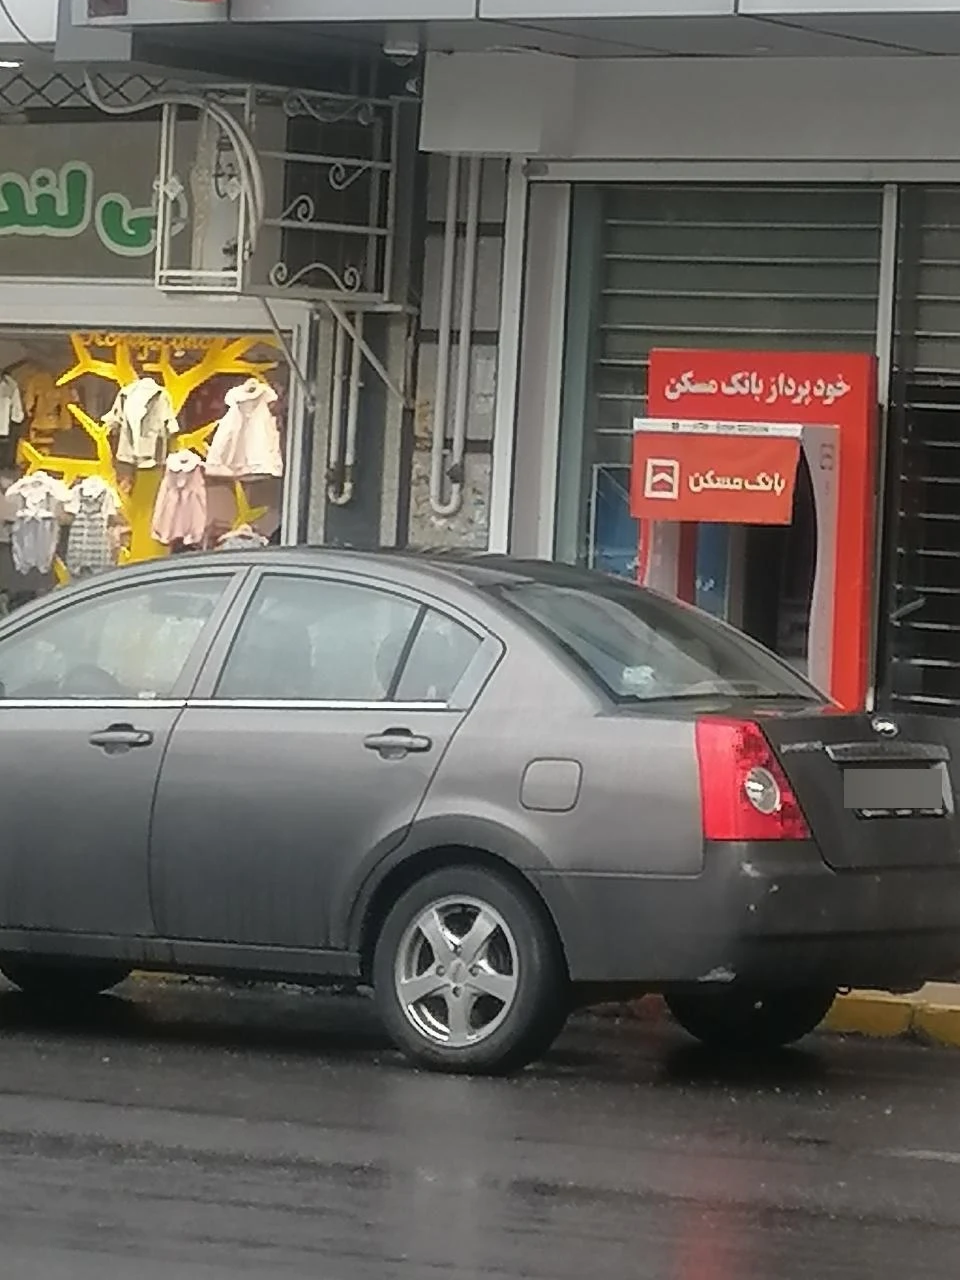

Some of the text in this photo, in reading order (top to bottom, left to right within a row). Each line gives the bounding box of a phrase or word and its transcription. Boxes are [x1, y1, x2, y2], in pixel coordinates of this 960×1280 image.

[664, 370, 717, 401] مسکن
[721, 371, 764, 402] بانک
[688, 470, 786, 496] بانک مسکن
